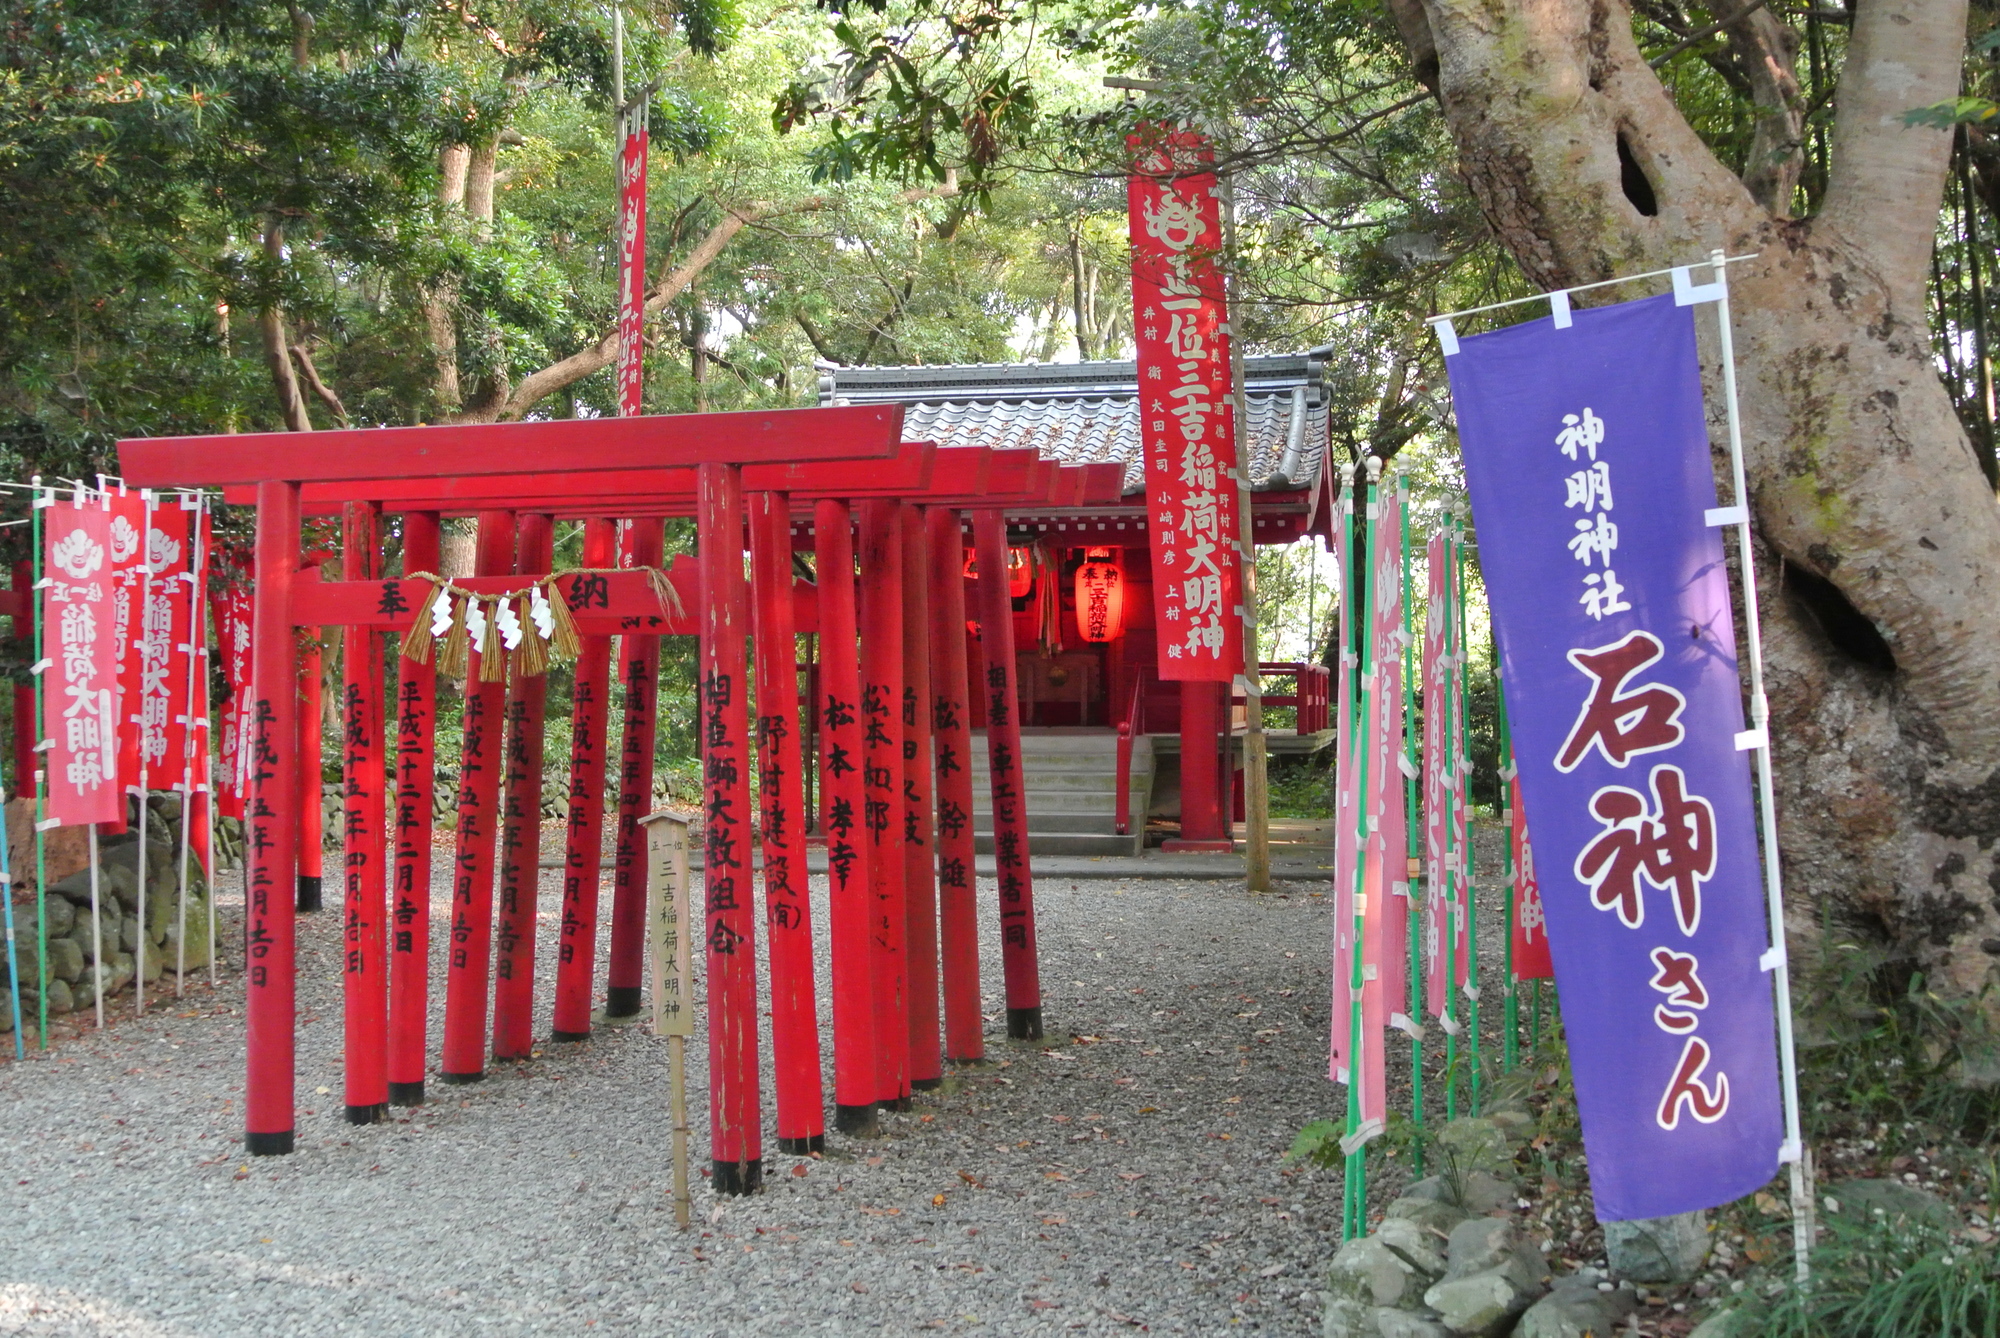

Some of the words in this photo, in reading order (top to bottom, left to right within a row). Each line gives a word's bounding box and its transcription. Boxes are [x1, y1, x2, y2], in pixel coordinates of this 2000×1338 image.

[1160, 254, 1224, 660] 正一位三吉稲荷大明神
[1555, 407, 1631, 621] 神明神社
[249, 699, 278, 988] 平成十五年三月吉日
[395, 681, 426, 954] 平成二十二年二月吉日
[453, 694, 484, 969] 平成十五年七月吉日
[498, 701, 531, 981] 平成十五年七月吉日
[559, 681, 593, 964] 平成十五年七月吉日
[651, 841, 683, 851] 正一位
[659, 860, 681, 1020] 三吉稲荷大明神
[1553, 630, 1730, 1131] 石神さん
